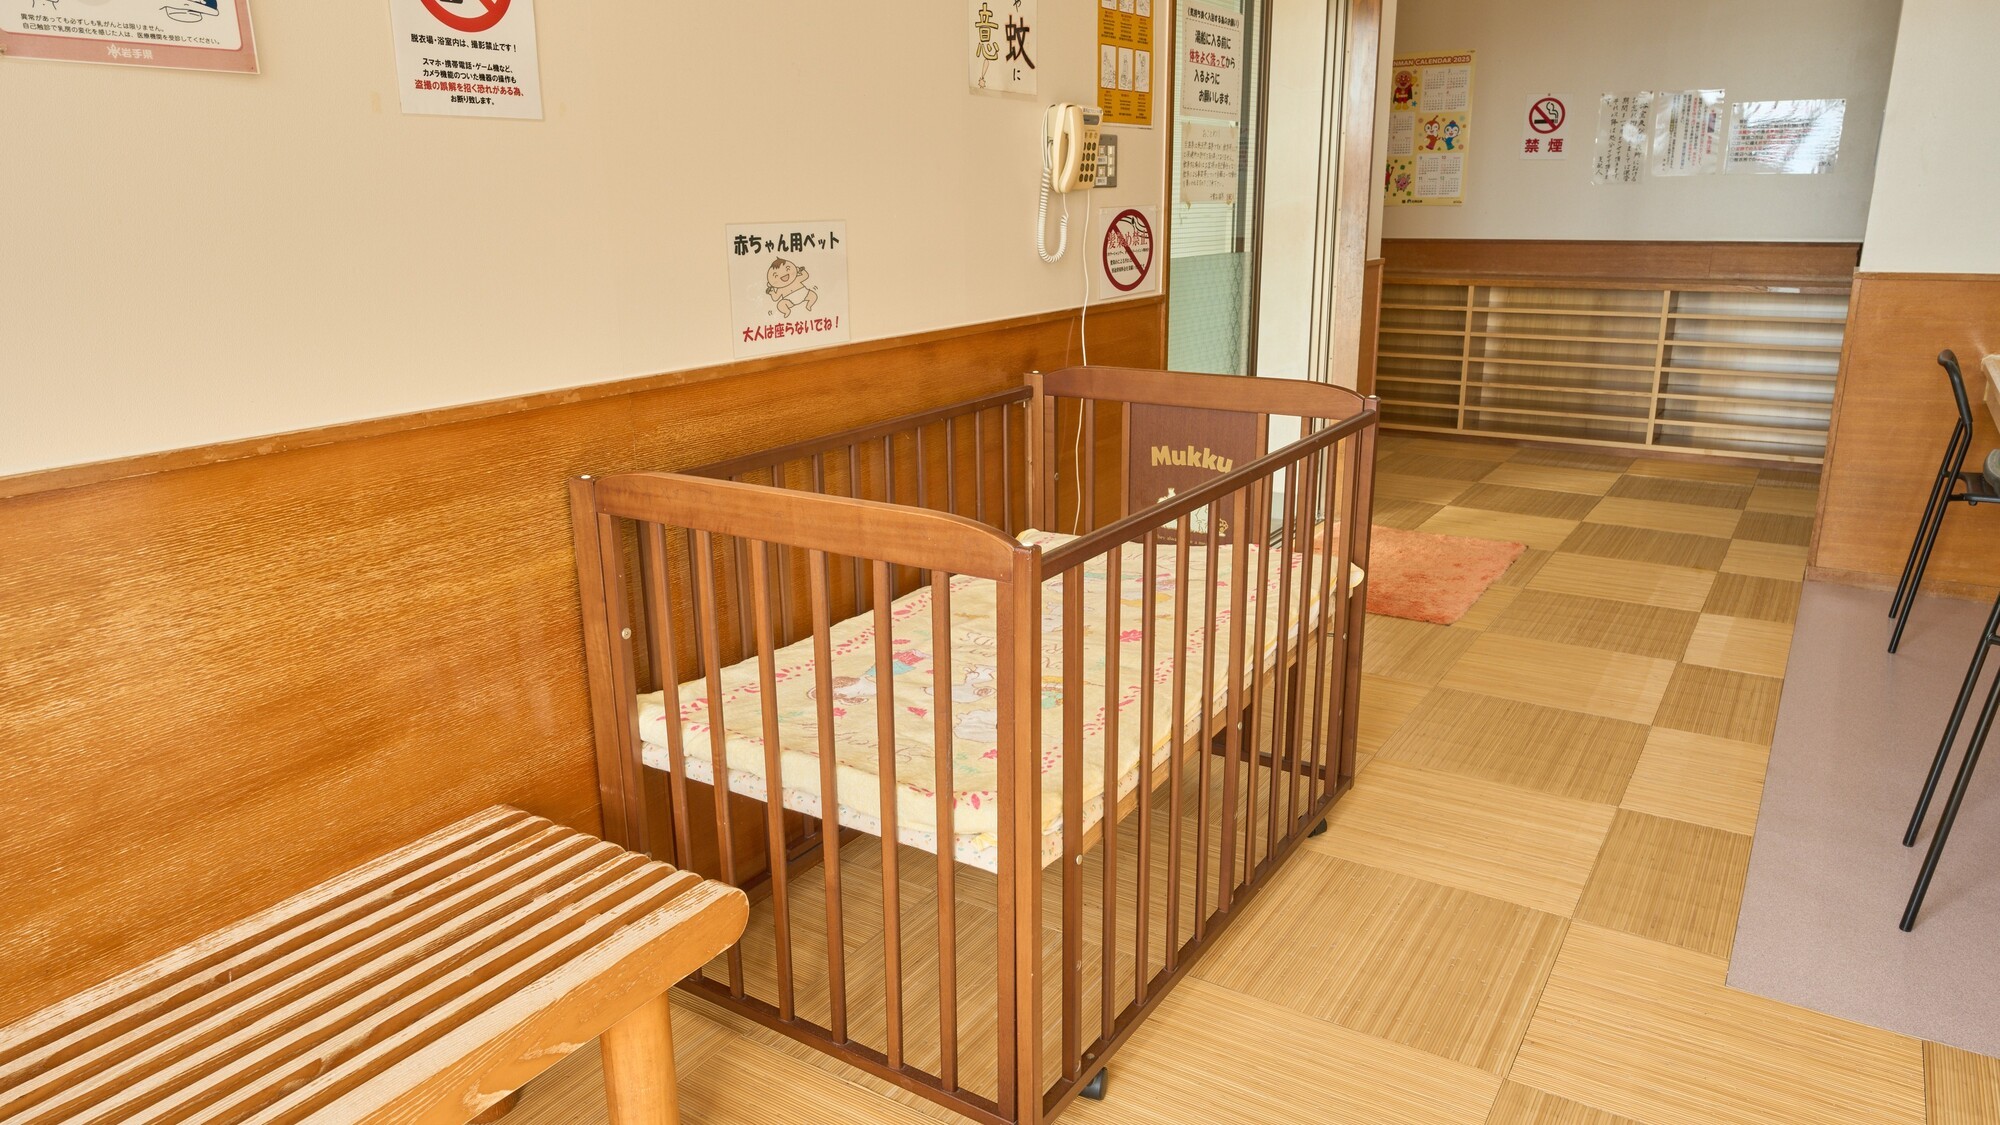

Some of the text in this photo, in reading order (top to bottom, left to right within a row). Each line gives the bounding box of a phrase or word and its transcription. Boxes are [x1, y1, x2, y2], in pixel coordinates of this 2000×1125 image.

[1194, 30, 1231, 49] 湯船に入る前に
[121, 48, 153, 59] 岩手県
[1189, 49, 1236, 68] 体をよく洗ってから
[1415, 56, 1452, 65] CALENDAR
[1453, 55, 1471, 63] 2025
[422, 69, 517, 84] カメラ機能のついた機器の操作も
[1193, 69, 1220, 85] 入るように
[450, 95, 495, 105] お断り致します。
[1198, 90, 1231, 105] お願いします。
[1524, 138, 1564, 153] 禁煙
[1151, 445, 1233, 473] Mukku
